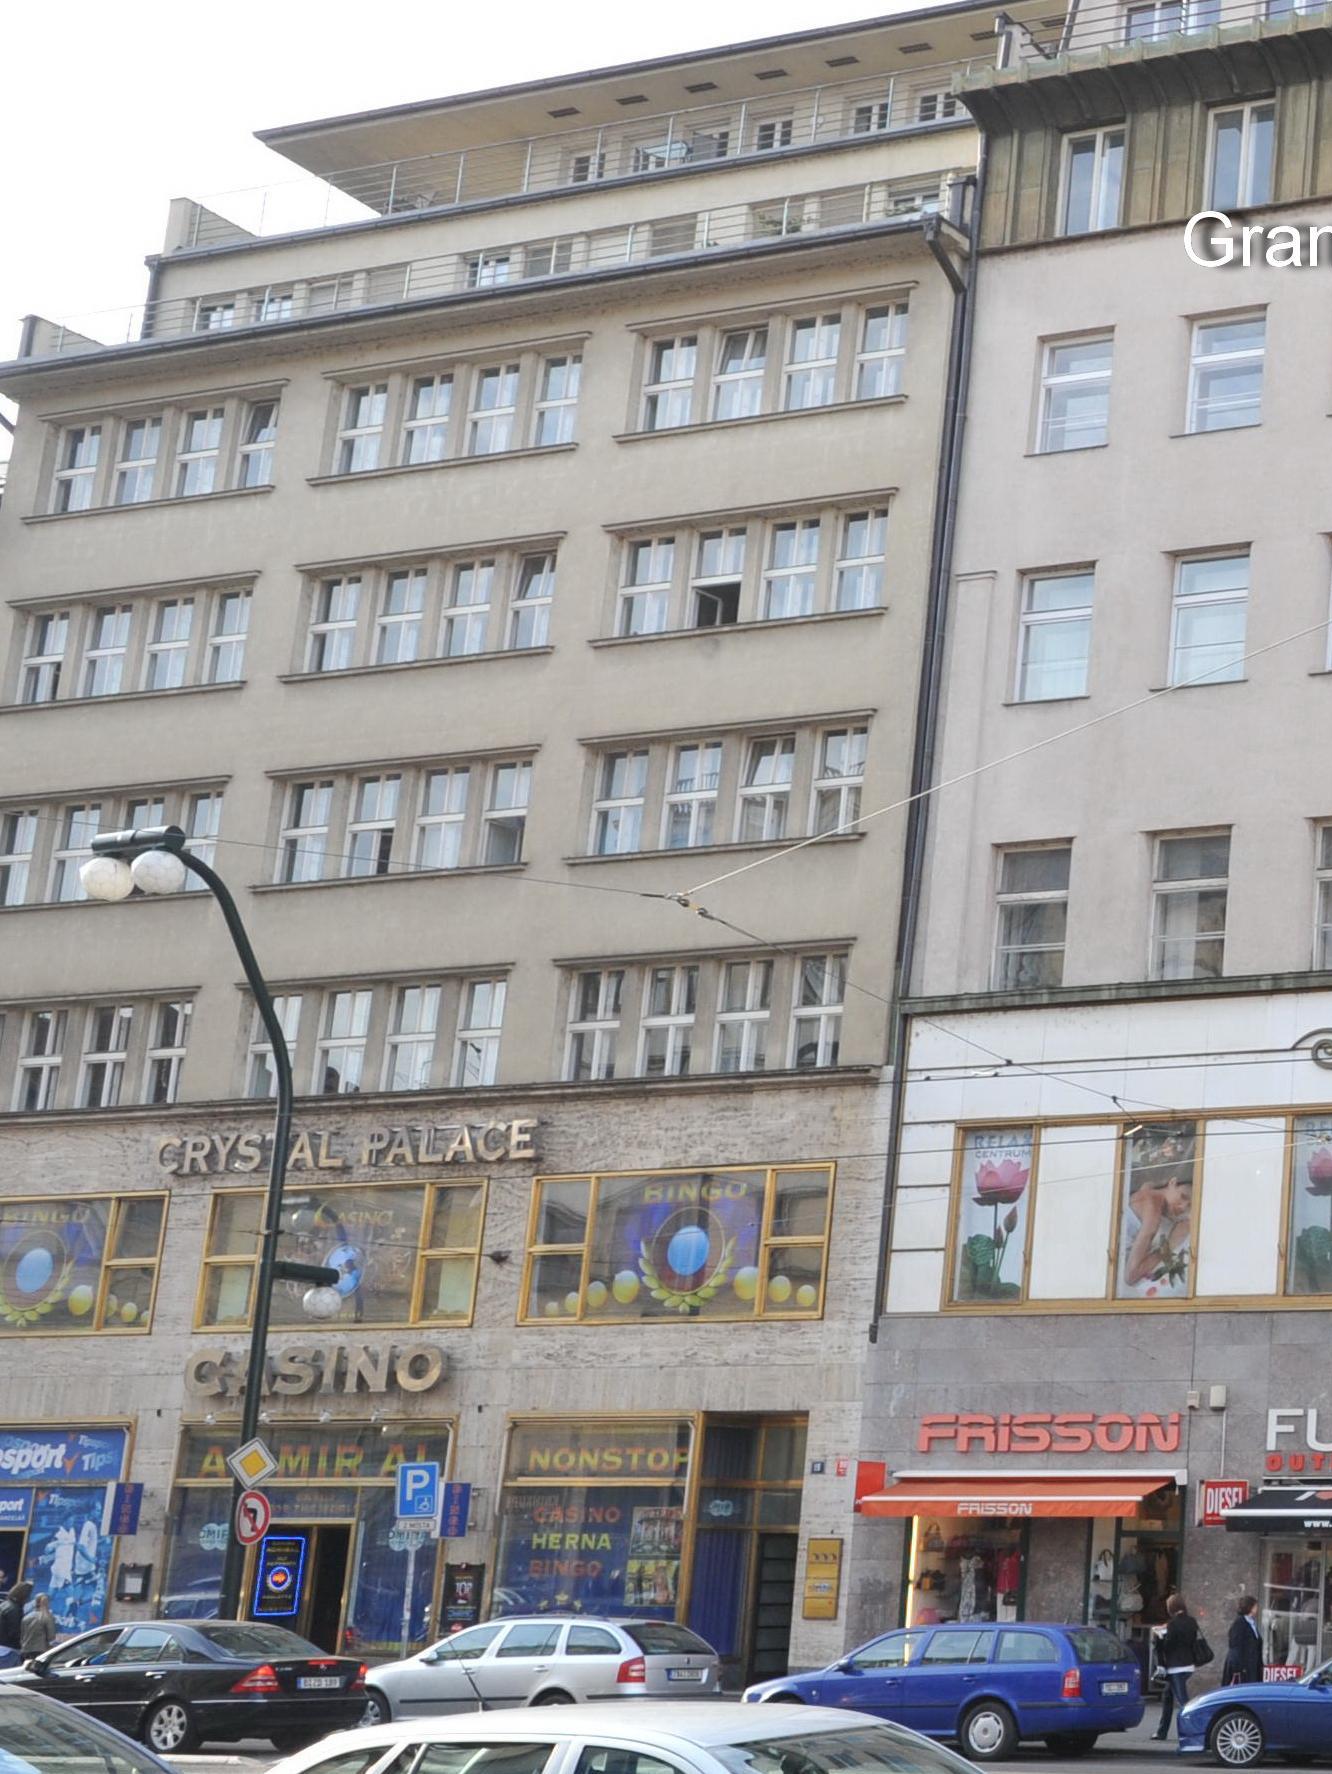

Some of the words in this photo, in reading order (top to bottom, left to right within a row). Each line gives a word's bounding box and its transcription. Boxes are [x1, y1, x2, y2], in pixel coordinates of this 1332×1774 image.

[158, 1131, 345, 1174] CRYSAL
[361, 1119, 537, 1166] PALACE
[644, 1182, 747, 1203] BINGO
[315, 1202, 393, 1227] CASINO
[184, 1344, 444, 1397] CASINO
[917, 1412, 1182, 1453] FRISSON
[0, 1443, 67, 1475] sport
[198, 1443, 427, 1478] AMIRA
[528, 1448, 690, 1473] NONSTOP
[406, 1469, 430, 1501] P
[532, 1506, 621, 1524] CASINO
[957, 1503, 1032, 1515] FRISSON
[532, 1533, 612, 1550] HERNA
[528, 1559, 603, 1578] BINGO
